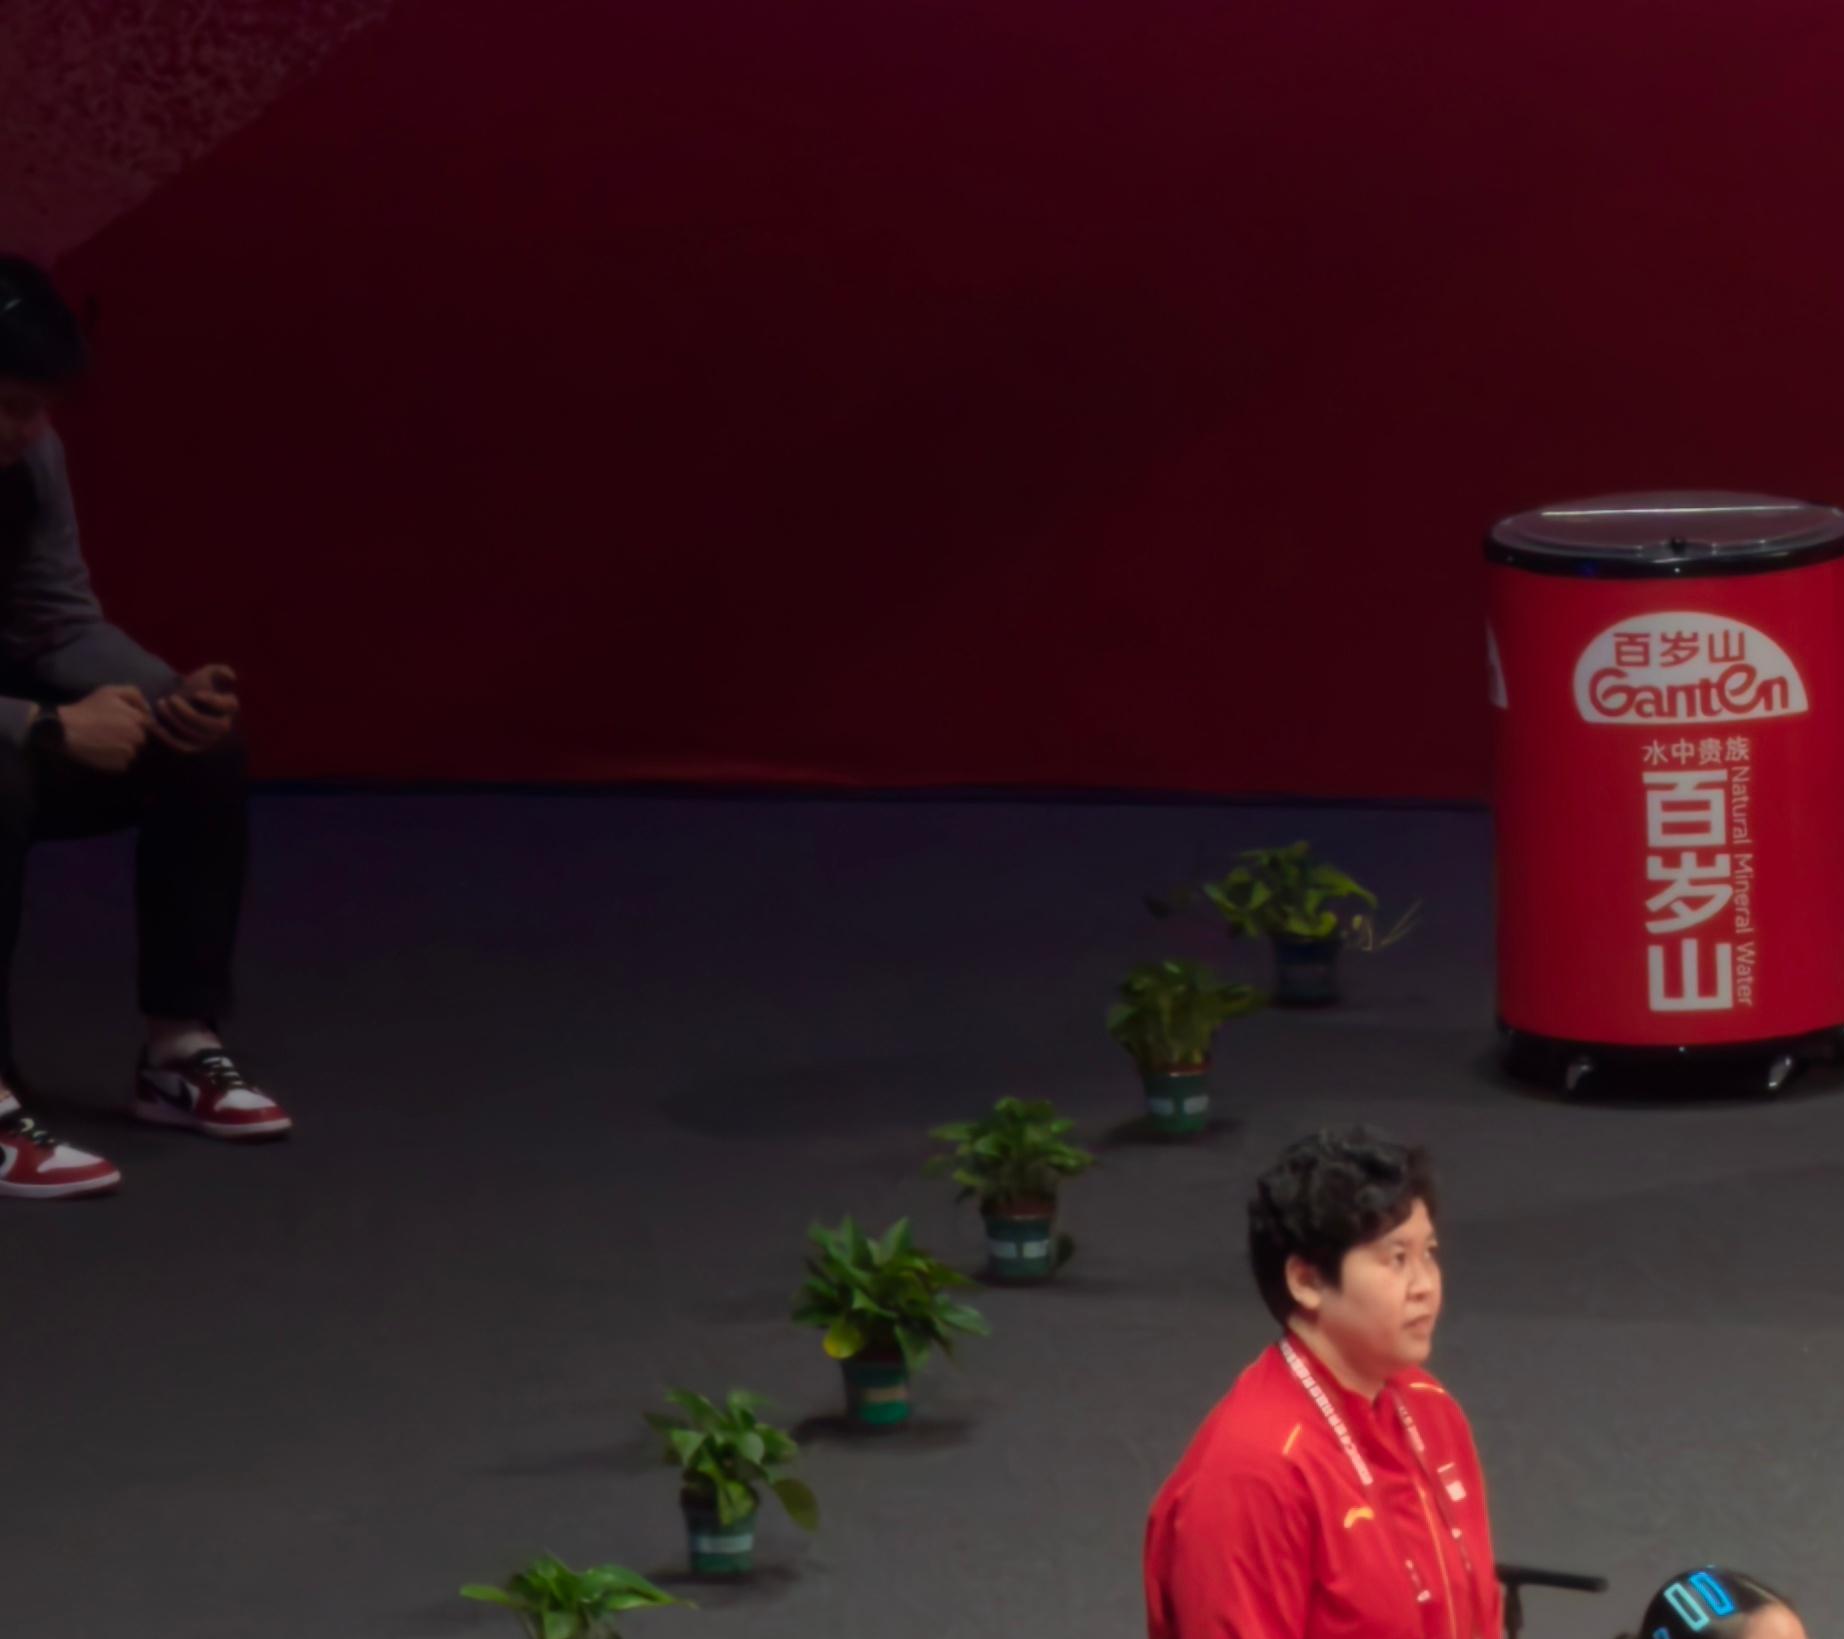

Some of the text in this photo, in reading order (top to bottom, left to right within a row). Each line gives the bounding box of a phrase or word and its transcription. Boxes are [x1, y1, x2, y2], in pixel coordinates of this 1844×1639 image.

[1614, 631, 1747, 668] 百岁山
[1588, 663, 1790, 721] Ganten
[1643, 735, 1750, 766] 水中贵族
[1642, 769, 1734, 1012] 百岁山
[1731, 765, 1754, 1008] Natural Mineral Water
